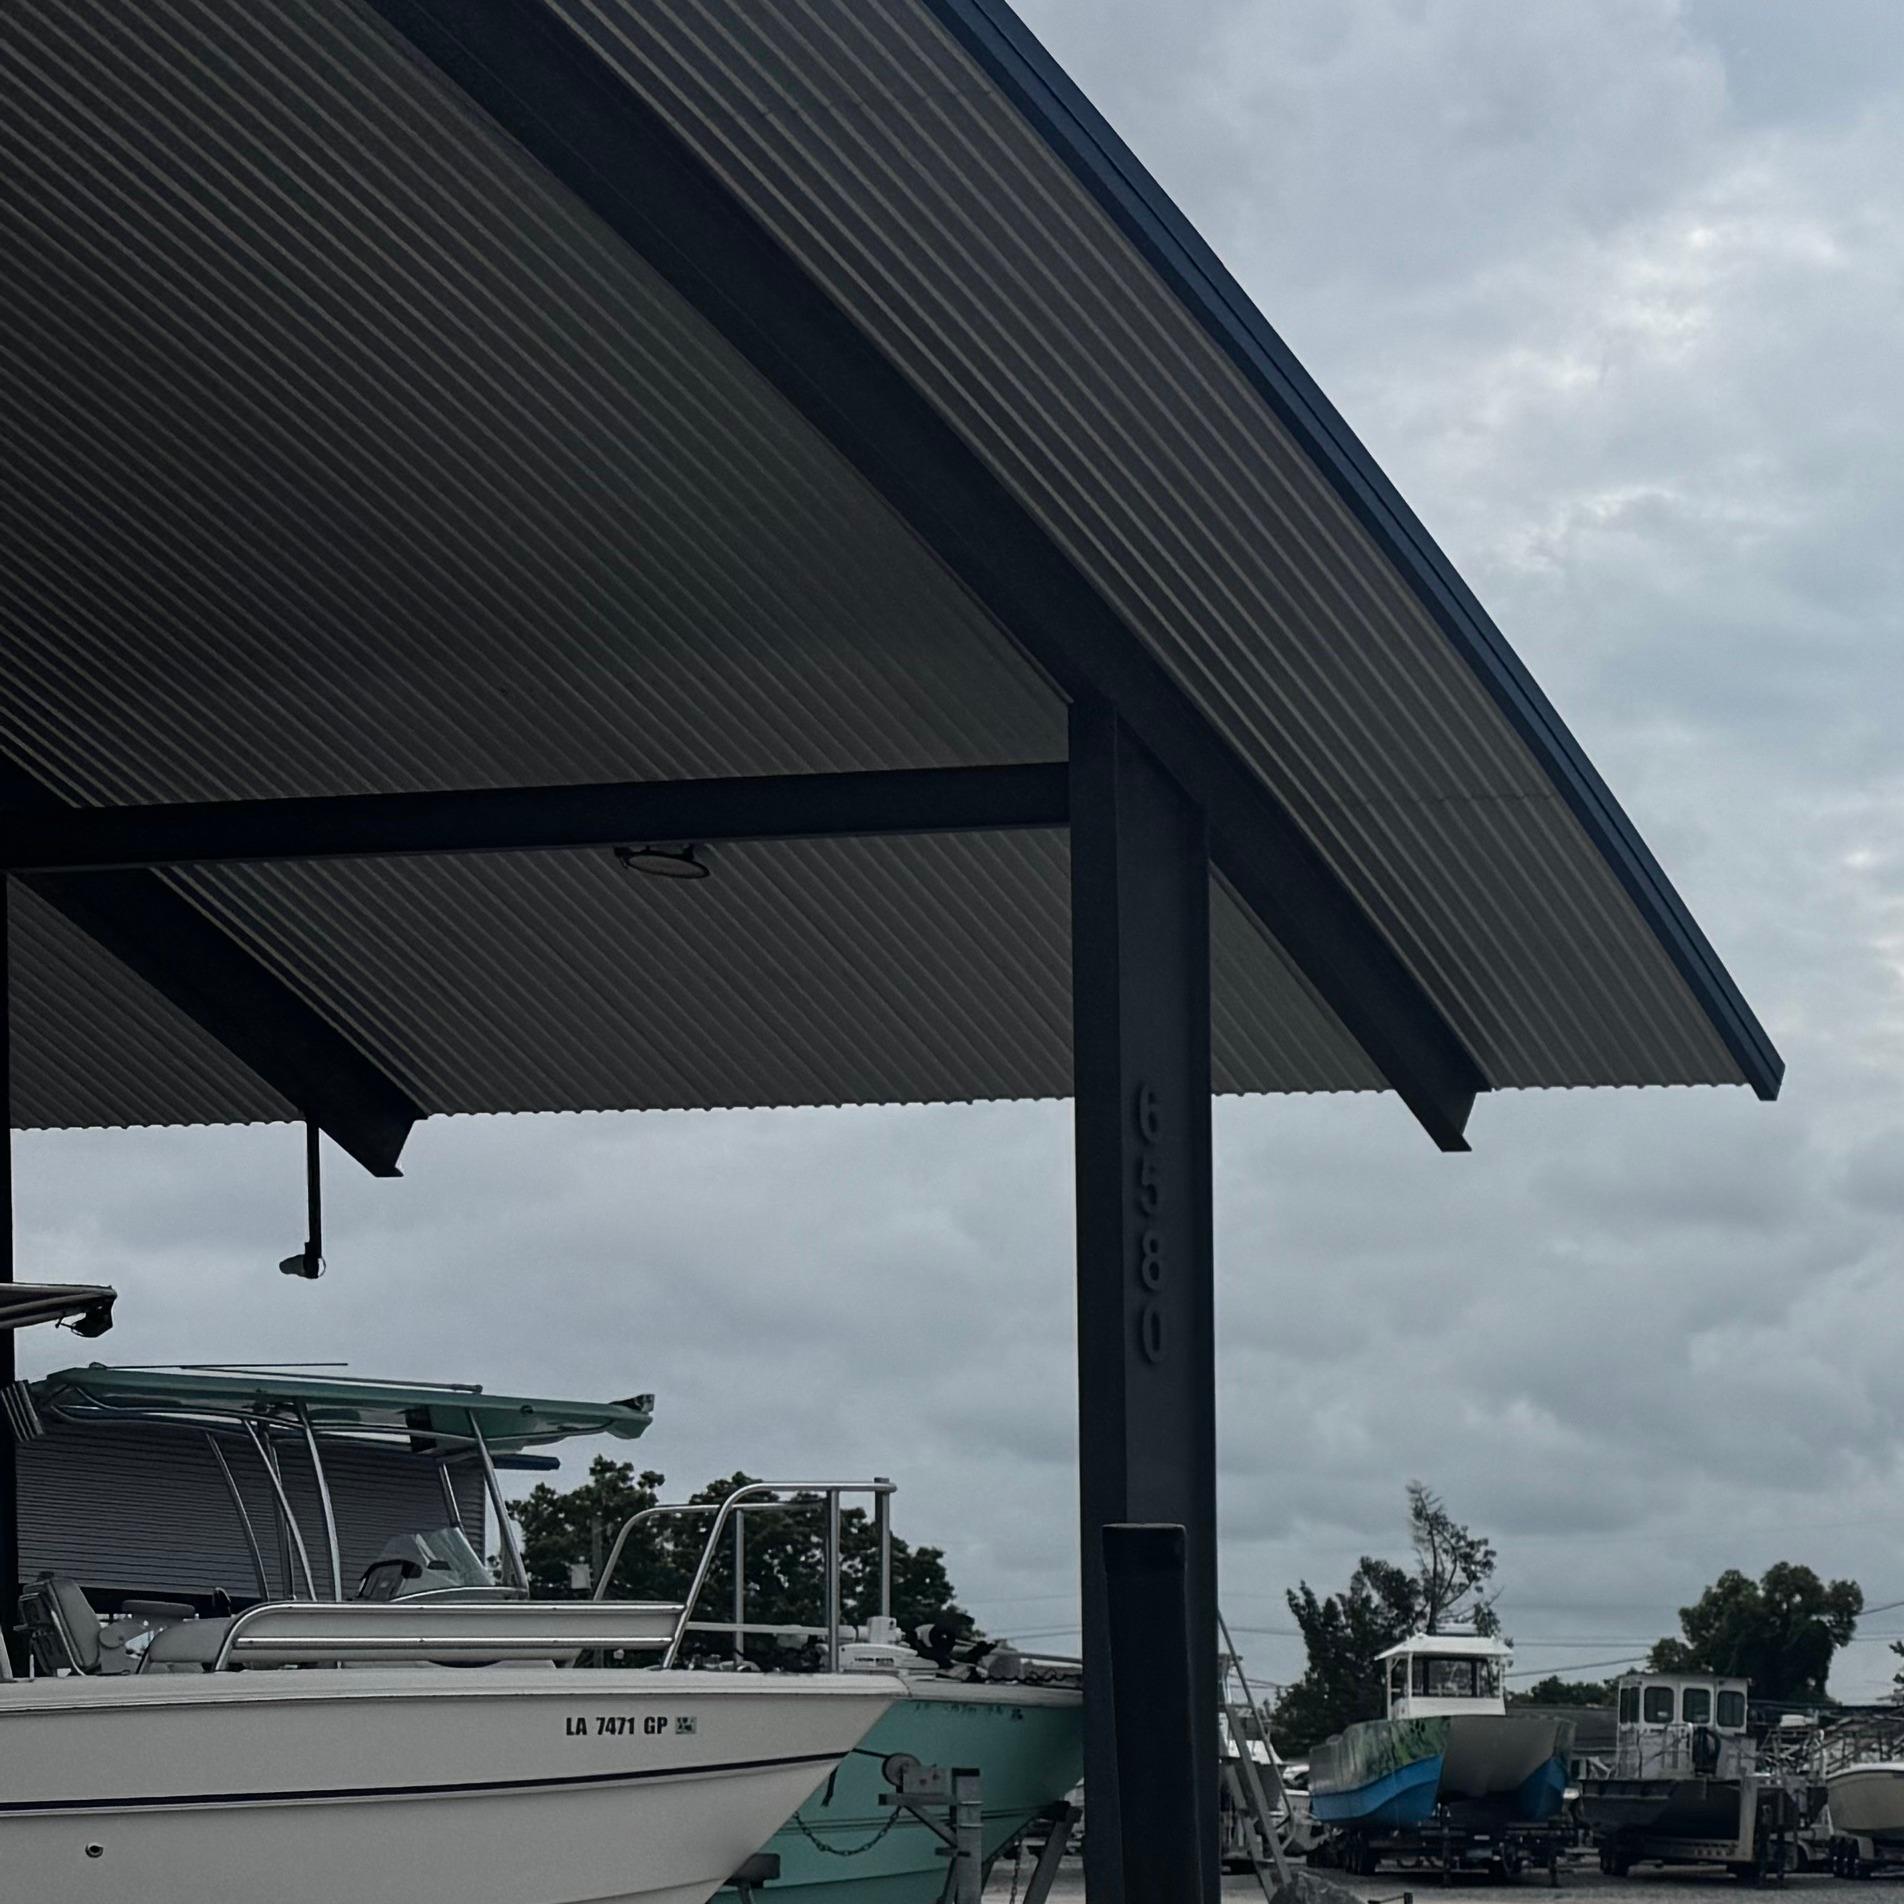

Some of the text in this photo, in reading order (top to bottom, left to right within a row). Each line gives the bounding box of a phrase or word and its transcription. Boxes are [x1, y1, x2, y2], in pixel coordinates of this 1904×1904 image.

[1137, 1083, 1166, 1364] 6580
[566, 1717, 587, 1736] LA
[596, 1717, 635, 1735] 7471
[643, 1716, 668, 1735] GP
